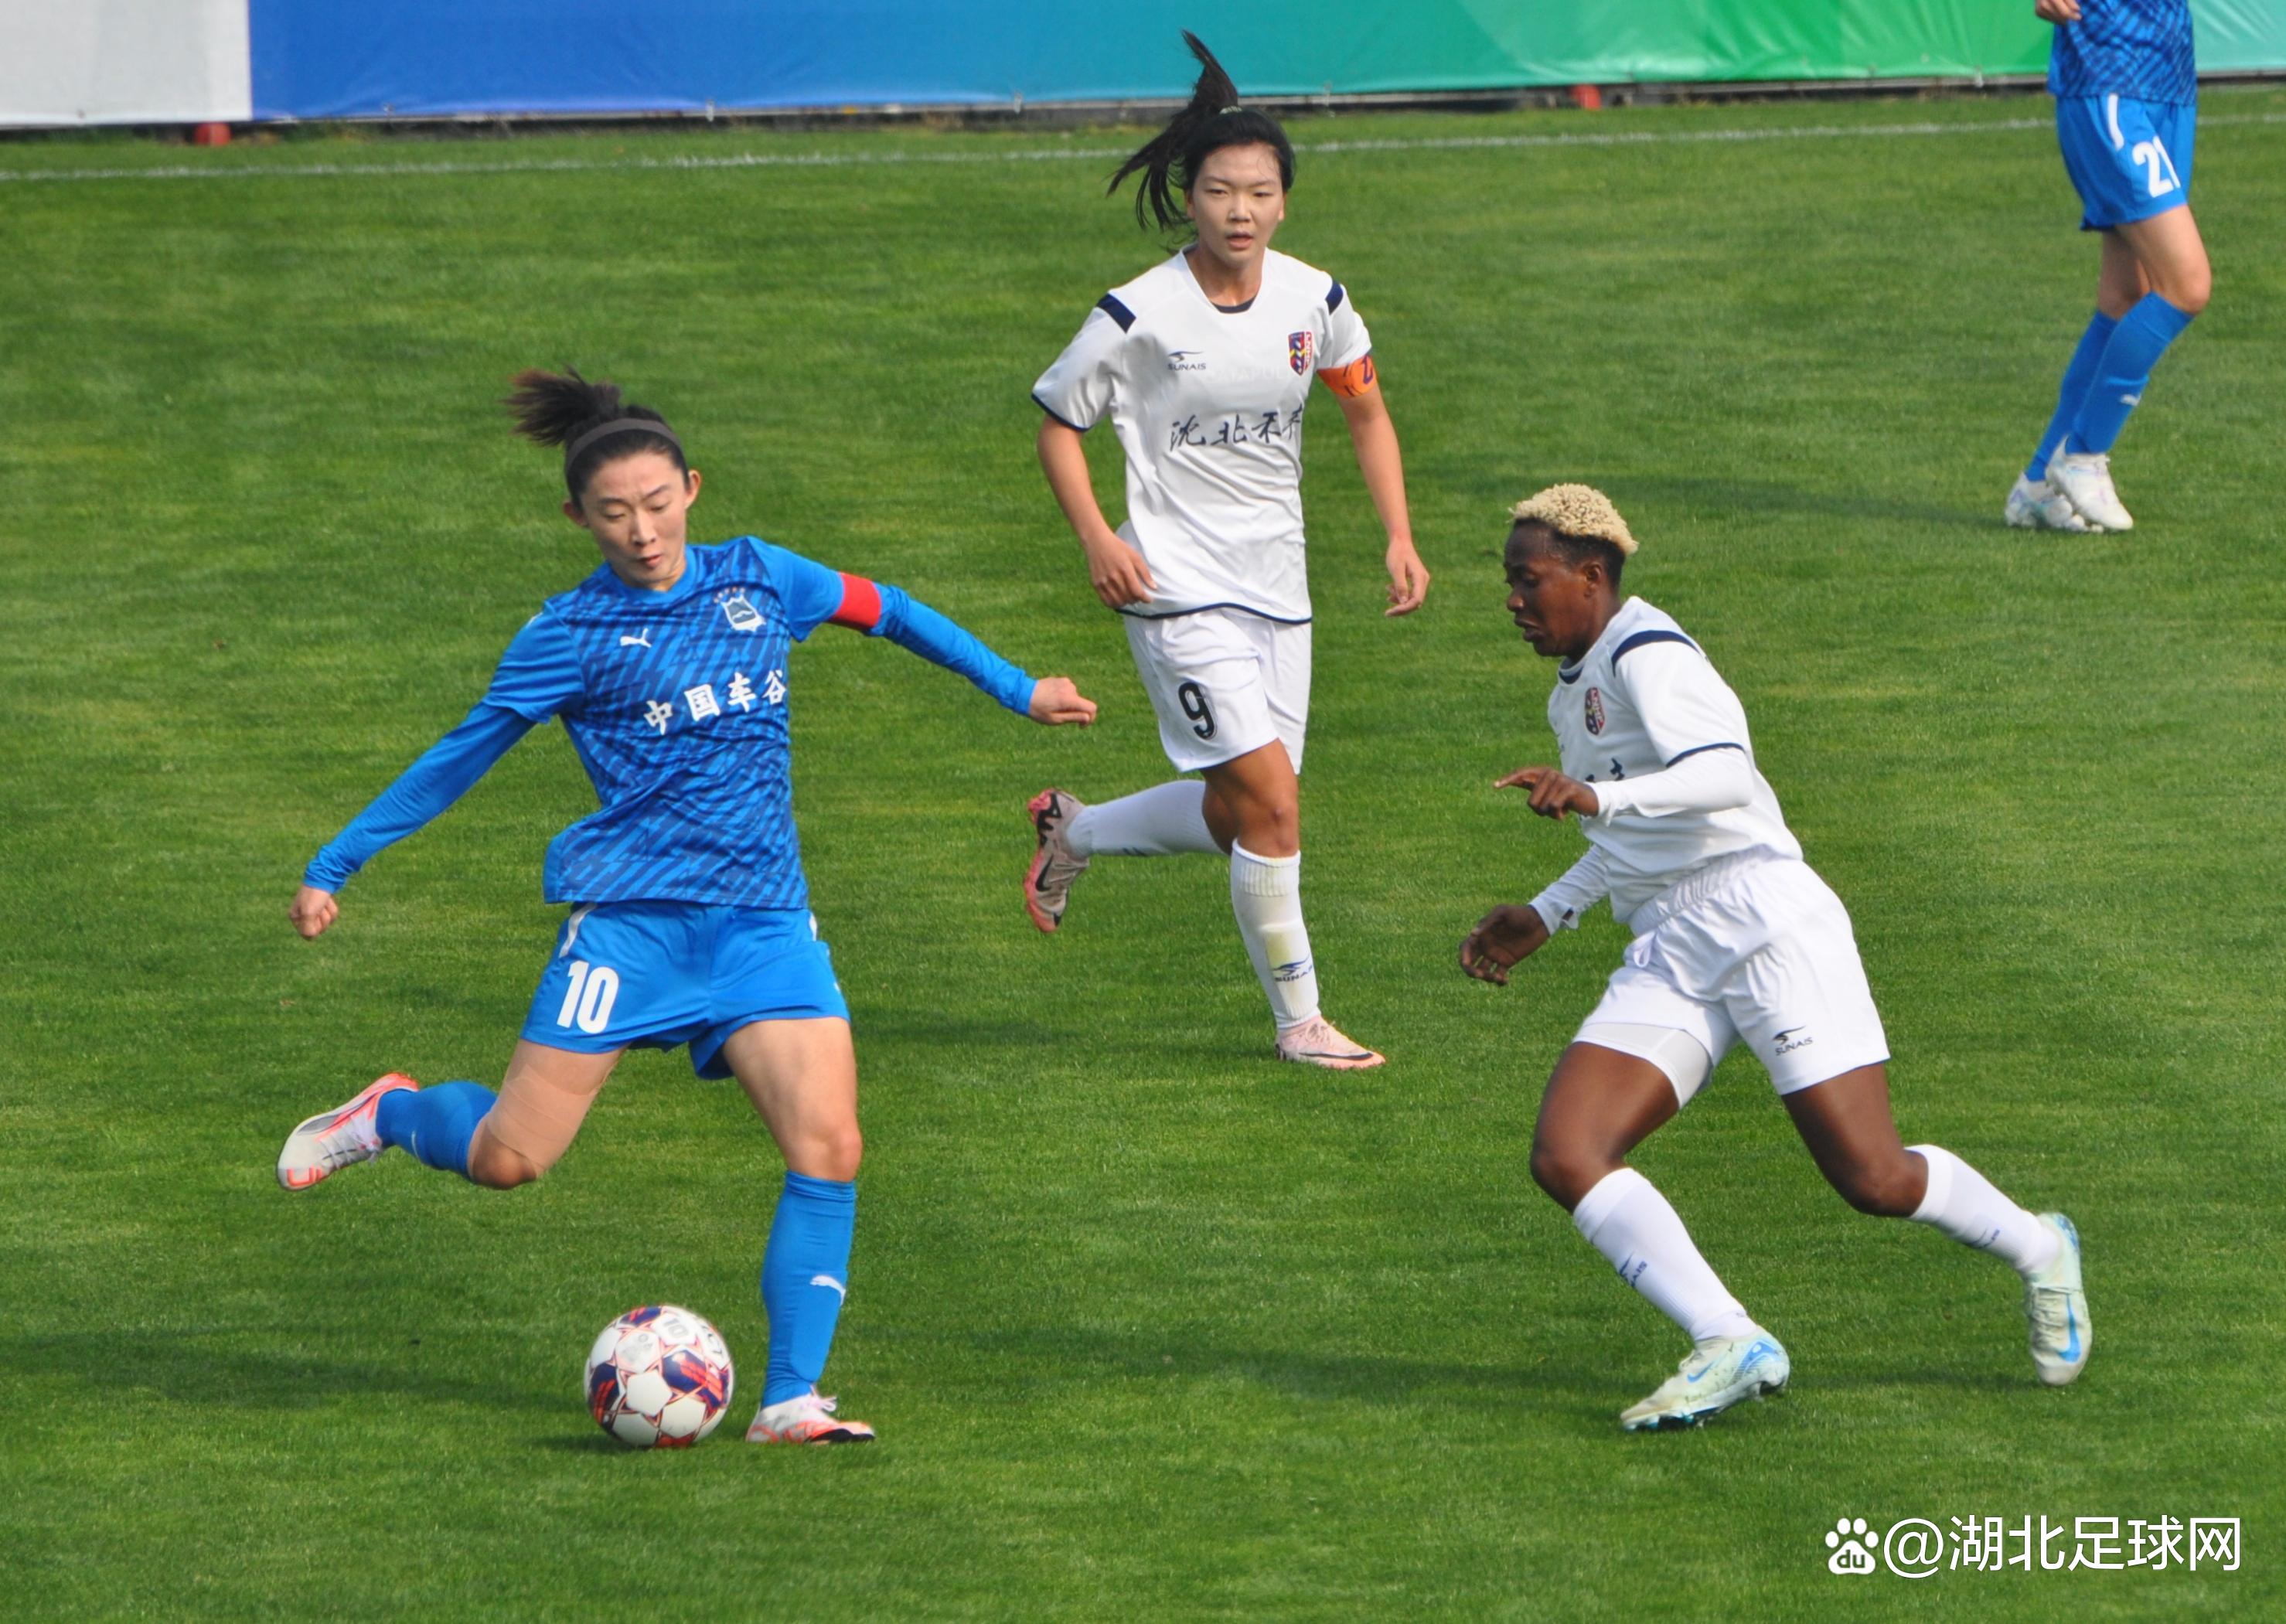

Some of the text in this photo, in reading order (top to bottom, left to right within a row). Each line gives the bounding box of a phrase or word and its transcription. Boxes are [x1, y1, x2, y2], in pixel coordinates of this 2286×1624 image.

[2131, 134, 2182, 199] 21
[1167, 363, 1207, 372] SUNAIS
[643, 669, 788, 736] 中国车谷
[1177, 681, 1216, 741] 9
[556, 959, 620, 1035] 10
